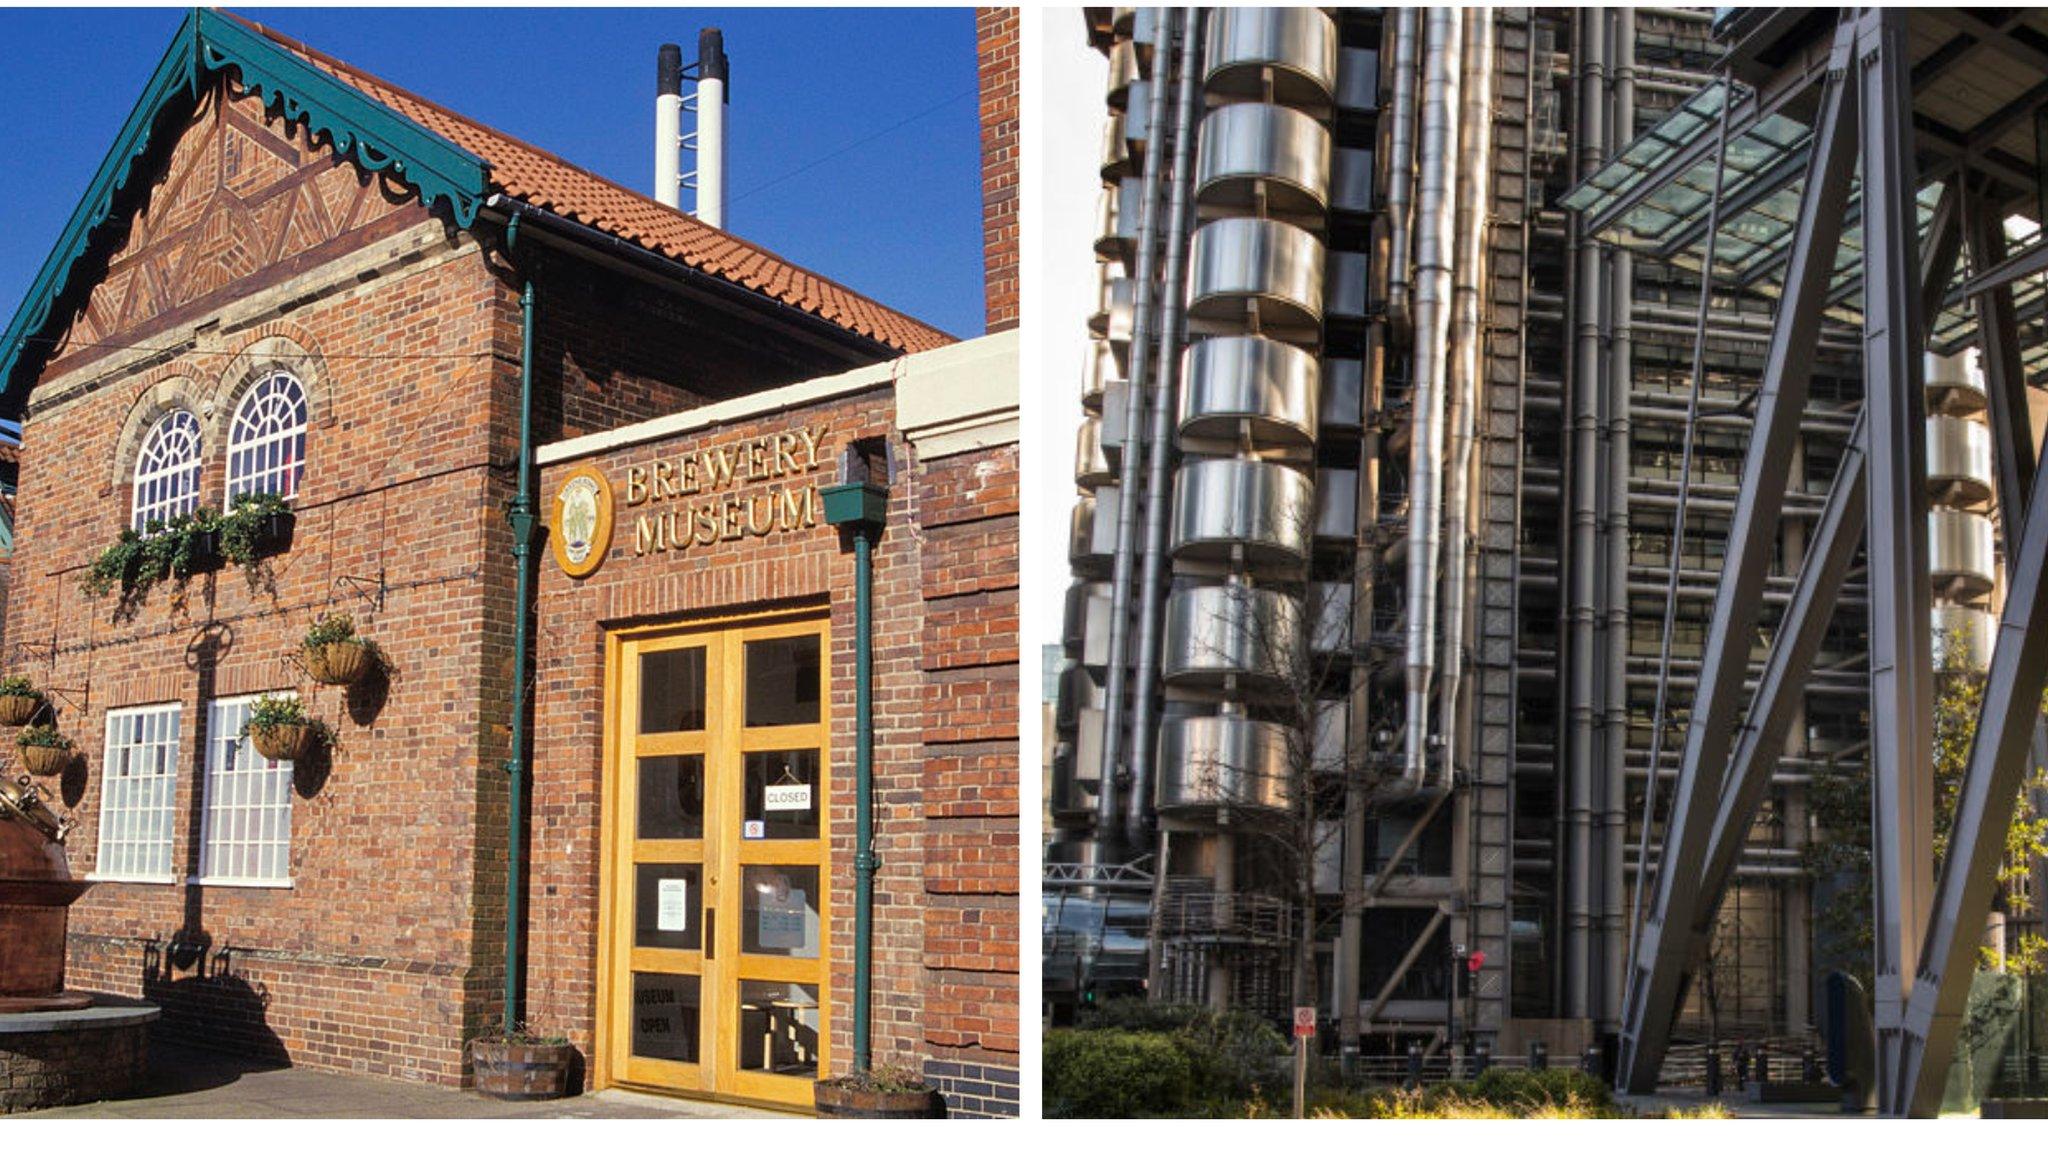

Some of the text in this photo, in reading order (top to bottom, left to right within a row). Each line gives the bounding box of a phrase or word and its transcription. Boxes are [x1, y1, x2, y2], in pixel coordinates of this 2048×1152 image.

[626, 424, 828, 507] BREWERY
[636, 484, 816, 557] MUSEUM
[767, 791, 808, 804] CLOSED
[635, 988, 675, 1005] USEUM
[641, 1017, 671, 1034] OPEN
